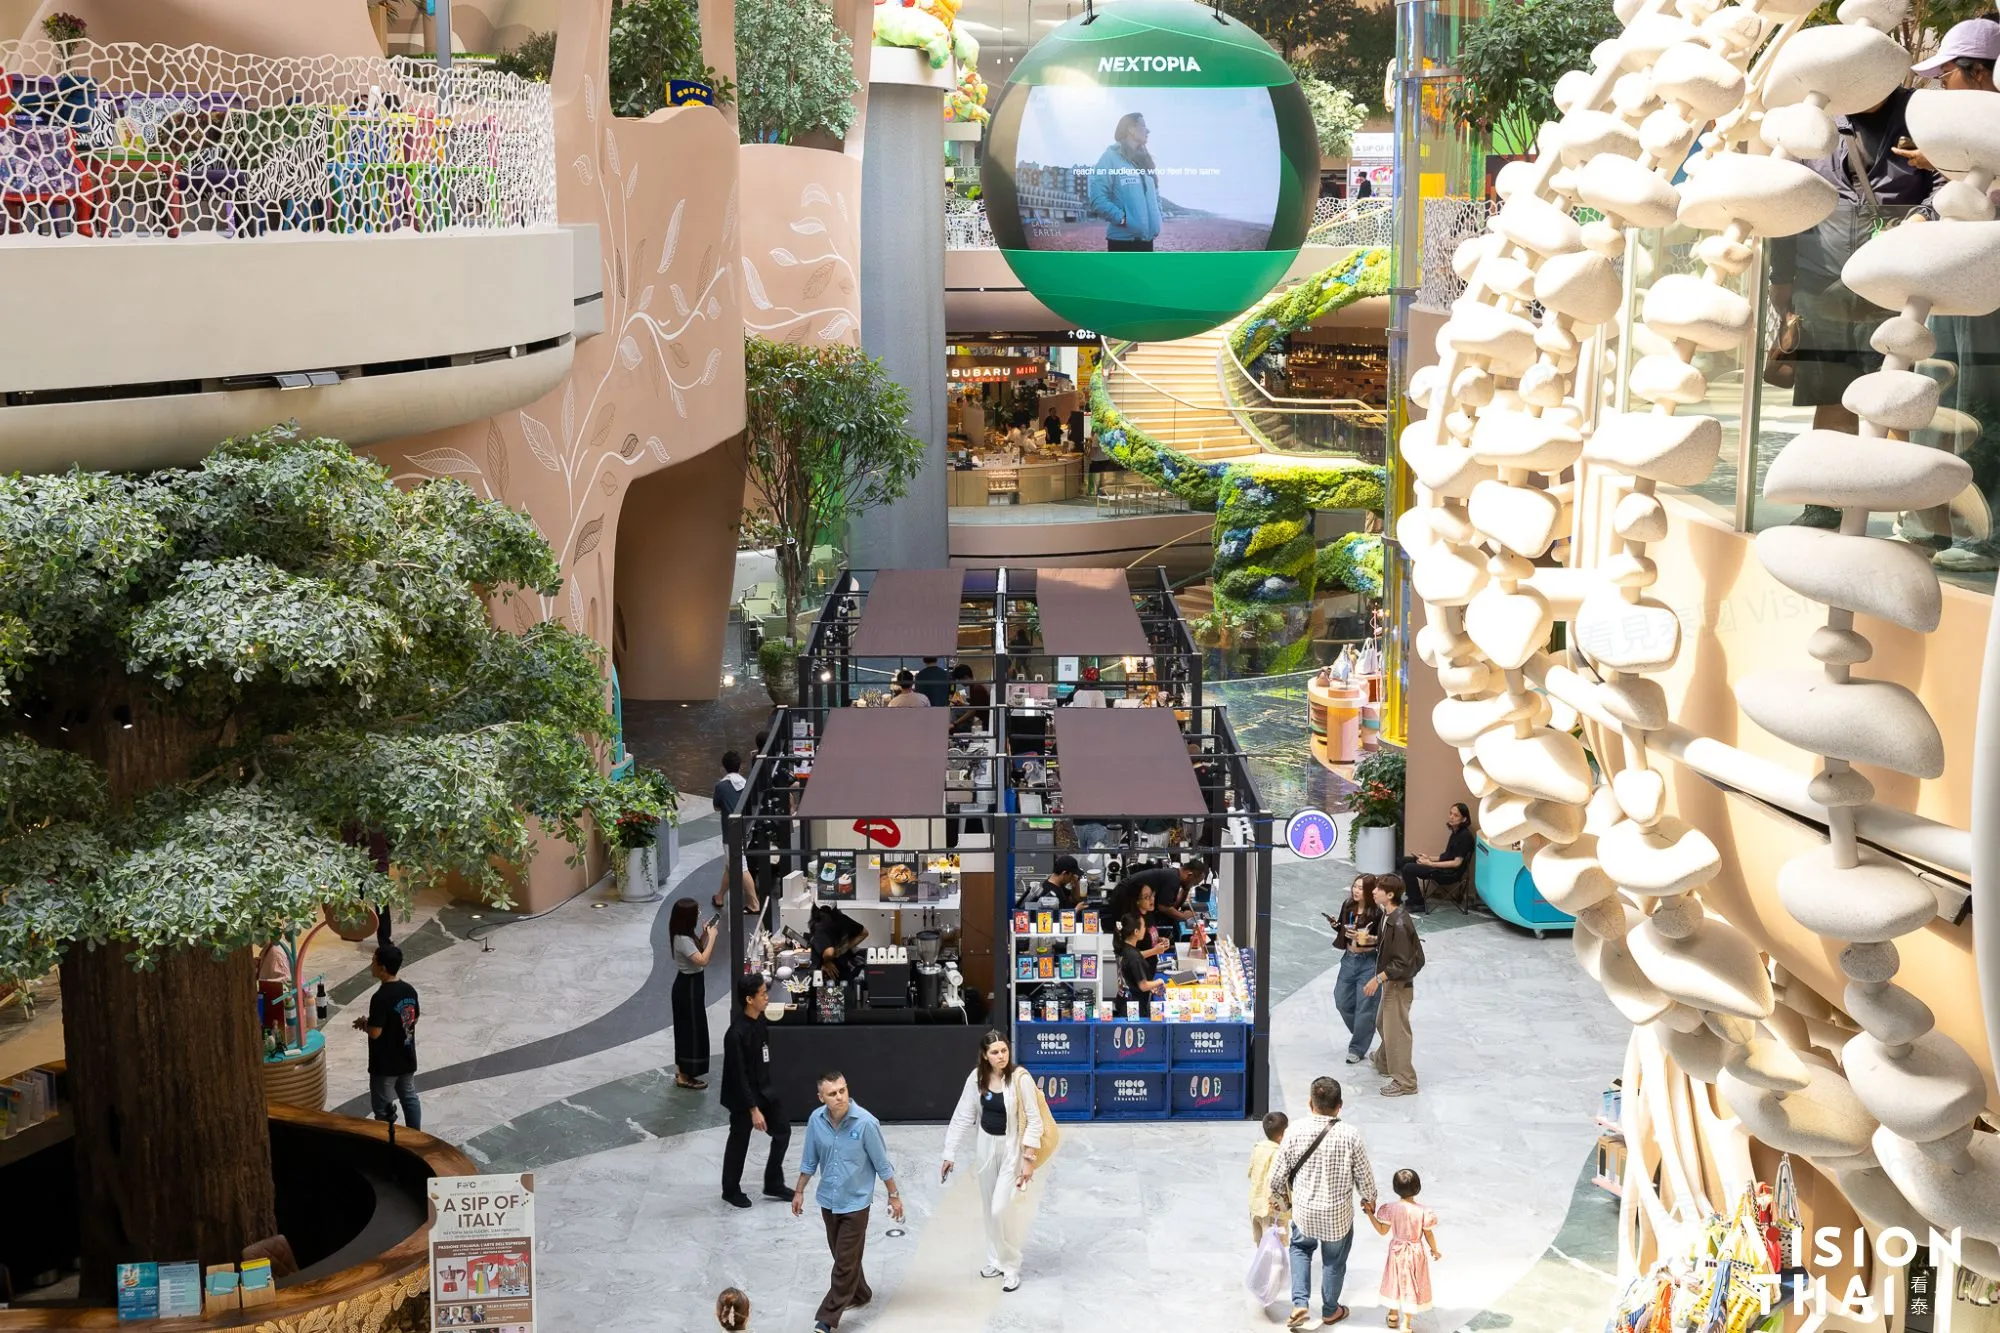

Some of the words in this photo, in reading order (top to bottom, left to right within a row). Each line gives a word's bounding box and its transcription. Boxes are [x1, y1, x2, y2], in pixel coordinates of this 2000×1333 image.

[1098, 56, 1201, 72] NEXTOPIA
[1073, 167, 1094, 175] reach
[1108, 167, 1145, 175] audience
[1016, 366, 1038, 375] MINI
[1036, 1033, 1068, 1041] CHOCO
[1190, 1031, 1221, 1040] CHOCO
[1114, 1079, 1145, 1088] CHOCO
[443, 1198, 457, 1212] A
[461, 1196, 490, 1211] SIP
[494, 1195, 519, 1209] OF
[458, 1212, 506, 1228] ITALY
